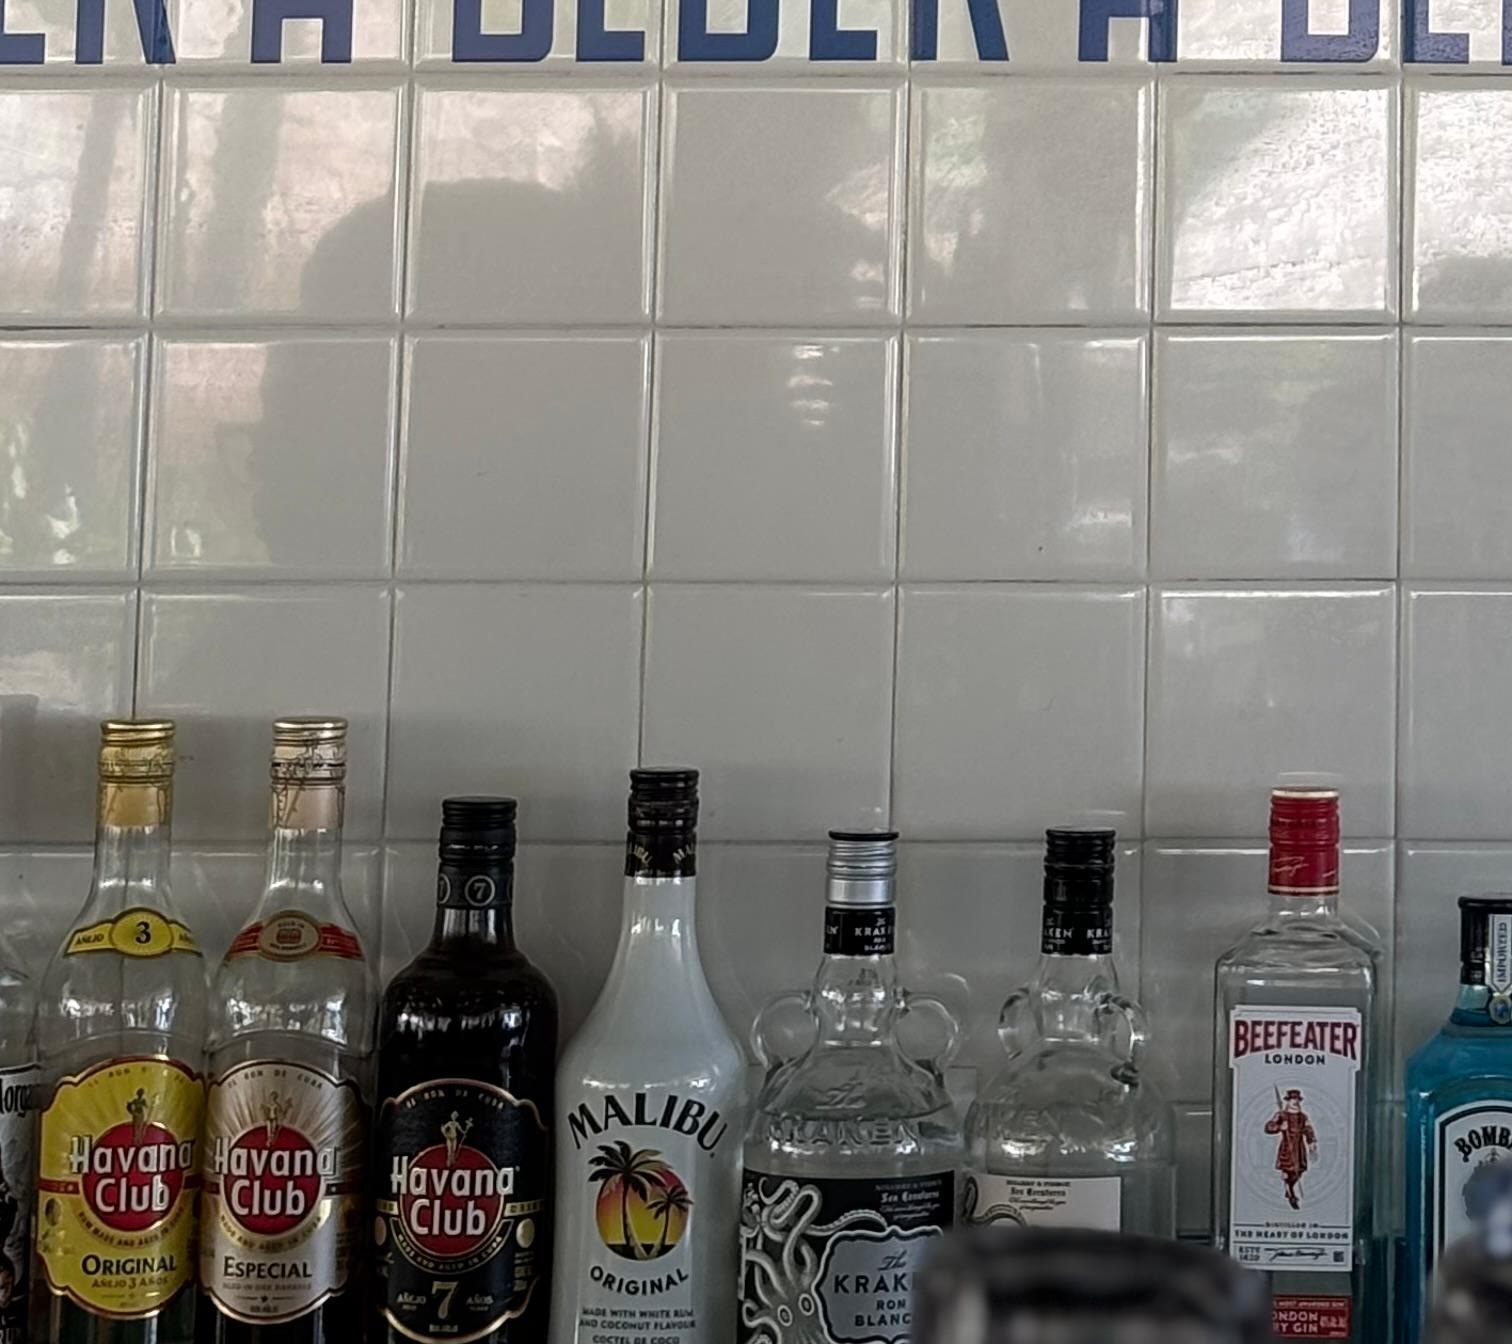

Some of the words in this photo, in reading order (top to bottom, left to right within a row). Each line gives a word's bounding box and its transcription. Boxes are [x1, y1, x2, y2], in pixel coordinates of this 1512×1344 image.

[135, 921, 152, 944] 3
[1234, 1019, 1357, 1061] BEEFEATER
[1264, 1053, 1326, 1065] LONDON
[568, 1092, 729, 1152] MALIBU
[69, 1136, 194, 1175] Havana
[215, 1137, 337, 1177] Havana
[391, 1155, 515, 1197] Havana
[95, 1177, 171, 1213] Club
[230, 1178, 306, 1217] Club
[410, 1198, 487, 1236] Club
[1306, 1230, 1349, 1240] LONDON
[81, 1254, 178, 1277] ORIGINAL
[223, 1255, 313, 1280] ESPECIAL
[128, 1277, 138, 1290] 3
[589, 1265, 689, 1296] ORIGINAL
[834, 1273, 909, 1294] KRAK
[432, 1281, 459, 1320] 7
[876, 1298, 907, 1311] RON
[600, 1319, 651, 1330] COCONUT
[854, 1312, 912, 1327] BLANC
[1292, 1323, 1319, 1334] GIN
